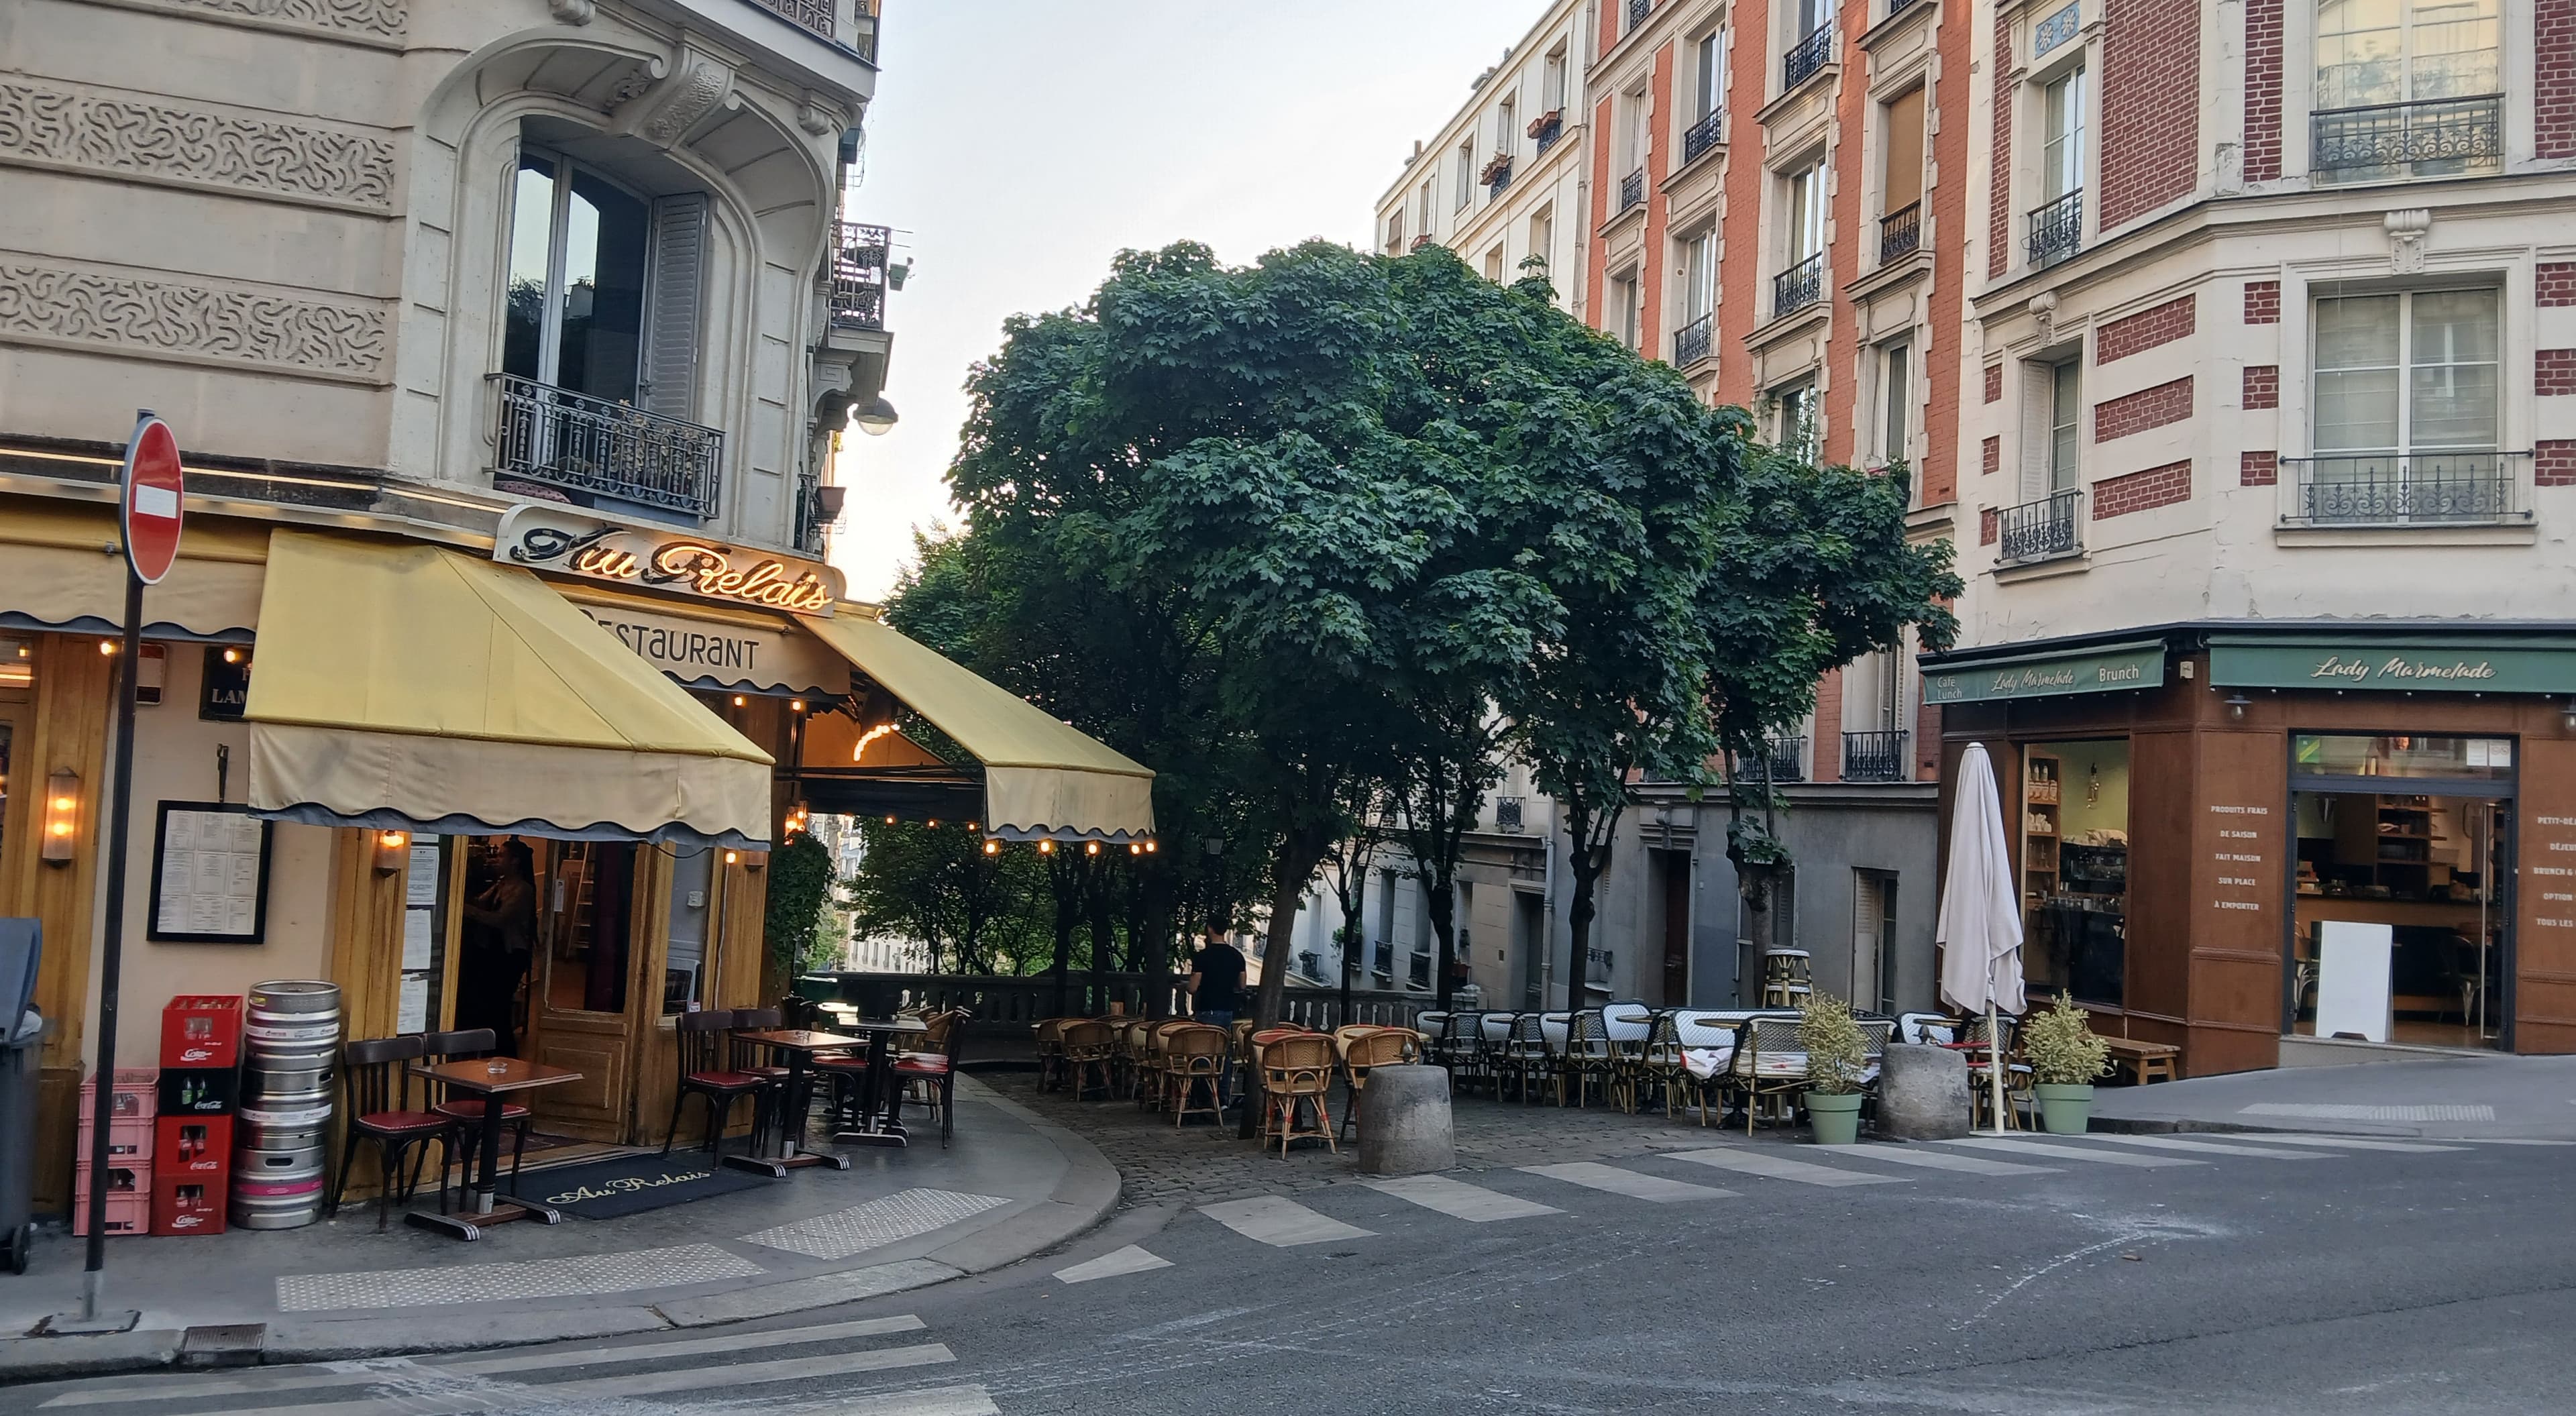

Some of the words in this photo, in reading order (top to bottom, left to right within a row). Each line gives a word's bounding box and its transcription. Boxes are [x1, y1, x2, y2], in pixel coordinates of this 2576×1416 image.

[508, 523, 643, 579] Au
[640, 541, 833, 610] Relais
[2099, 665, 2140, 682] Brunch
[2310, 656, 2371, 682] Lady
[2377, 657, 2498, 679] Marmelade
[1990, 672, 2018, 694] Lady
[2020, 669, 2074, 688] Marmelade
[1937, 688, 1963, 700] Lunch
[2211, 806, 2245, 814] PRODUITS
[2247, 807, 2268, 815] FRAIS
[2231, 830, 2257, 838] SAISON
[2233, 854, 2261, 862] MAISON
[2533, 867, 2565, 875] BRUNCH
[2235, 878, 2256, 886] PLACE
[2543, 893, 2573, 901] OPTION
[2221, 902, 2259, 911] EMPORTER
[2536, 918, 2557, 926] TOUS
[546, 1187, 616, 1205] Au
[606, 1171, 710, 1191] Relais
